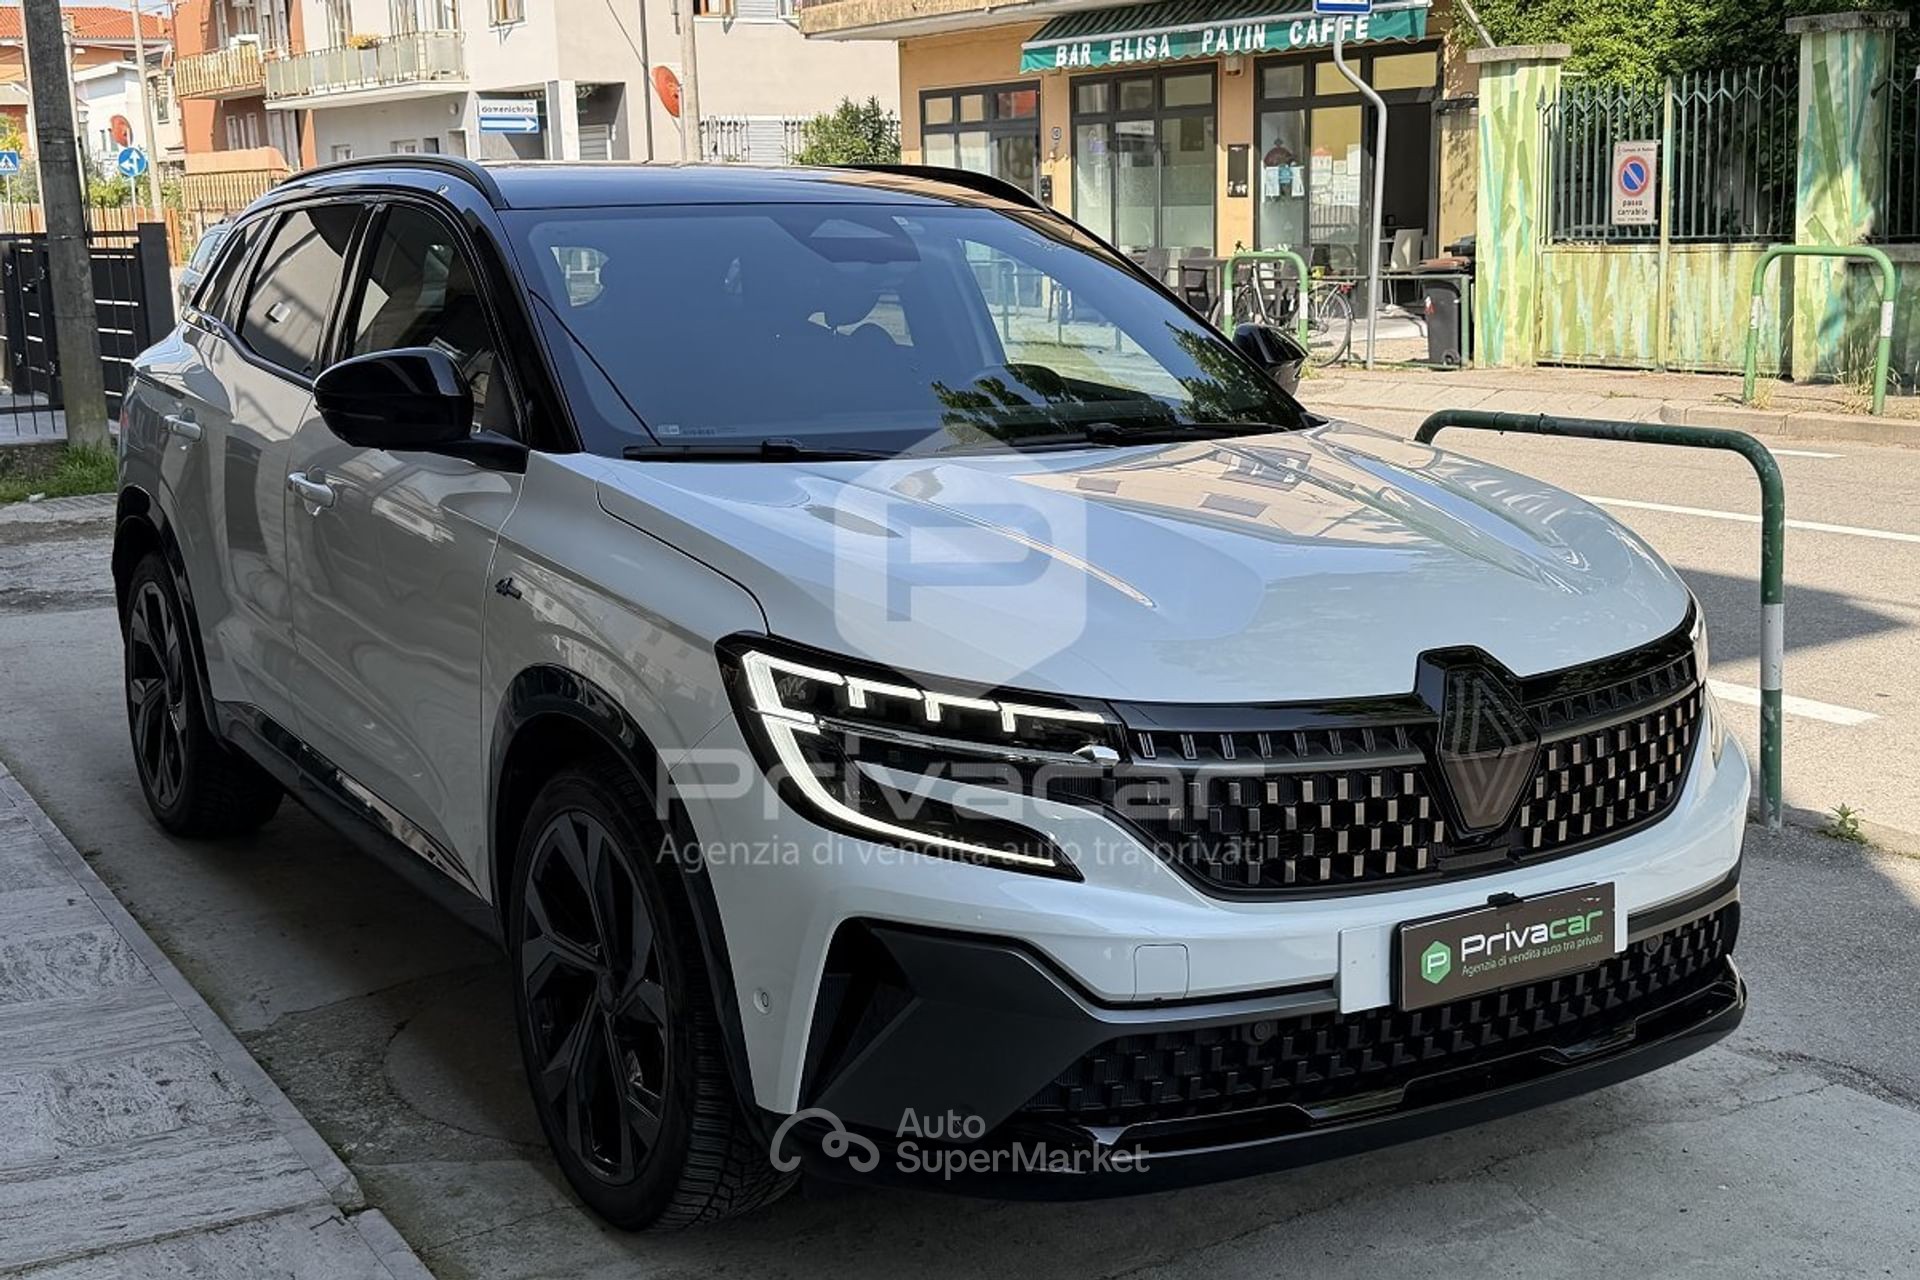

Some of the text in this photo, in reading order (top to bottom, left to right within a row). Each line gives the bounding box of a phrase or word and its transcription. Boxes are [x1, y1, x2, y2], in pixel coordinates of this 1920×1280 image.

[1055, 43, 1091, 67] BAR
[1109, 33, 1170, 62] ELISA
[1202, 24, 1265, 53] PAVIN
[1617, 208, 1648, 216] carrabile
[1461, 910, 1603, 962] Privacar
